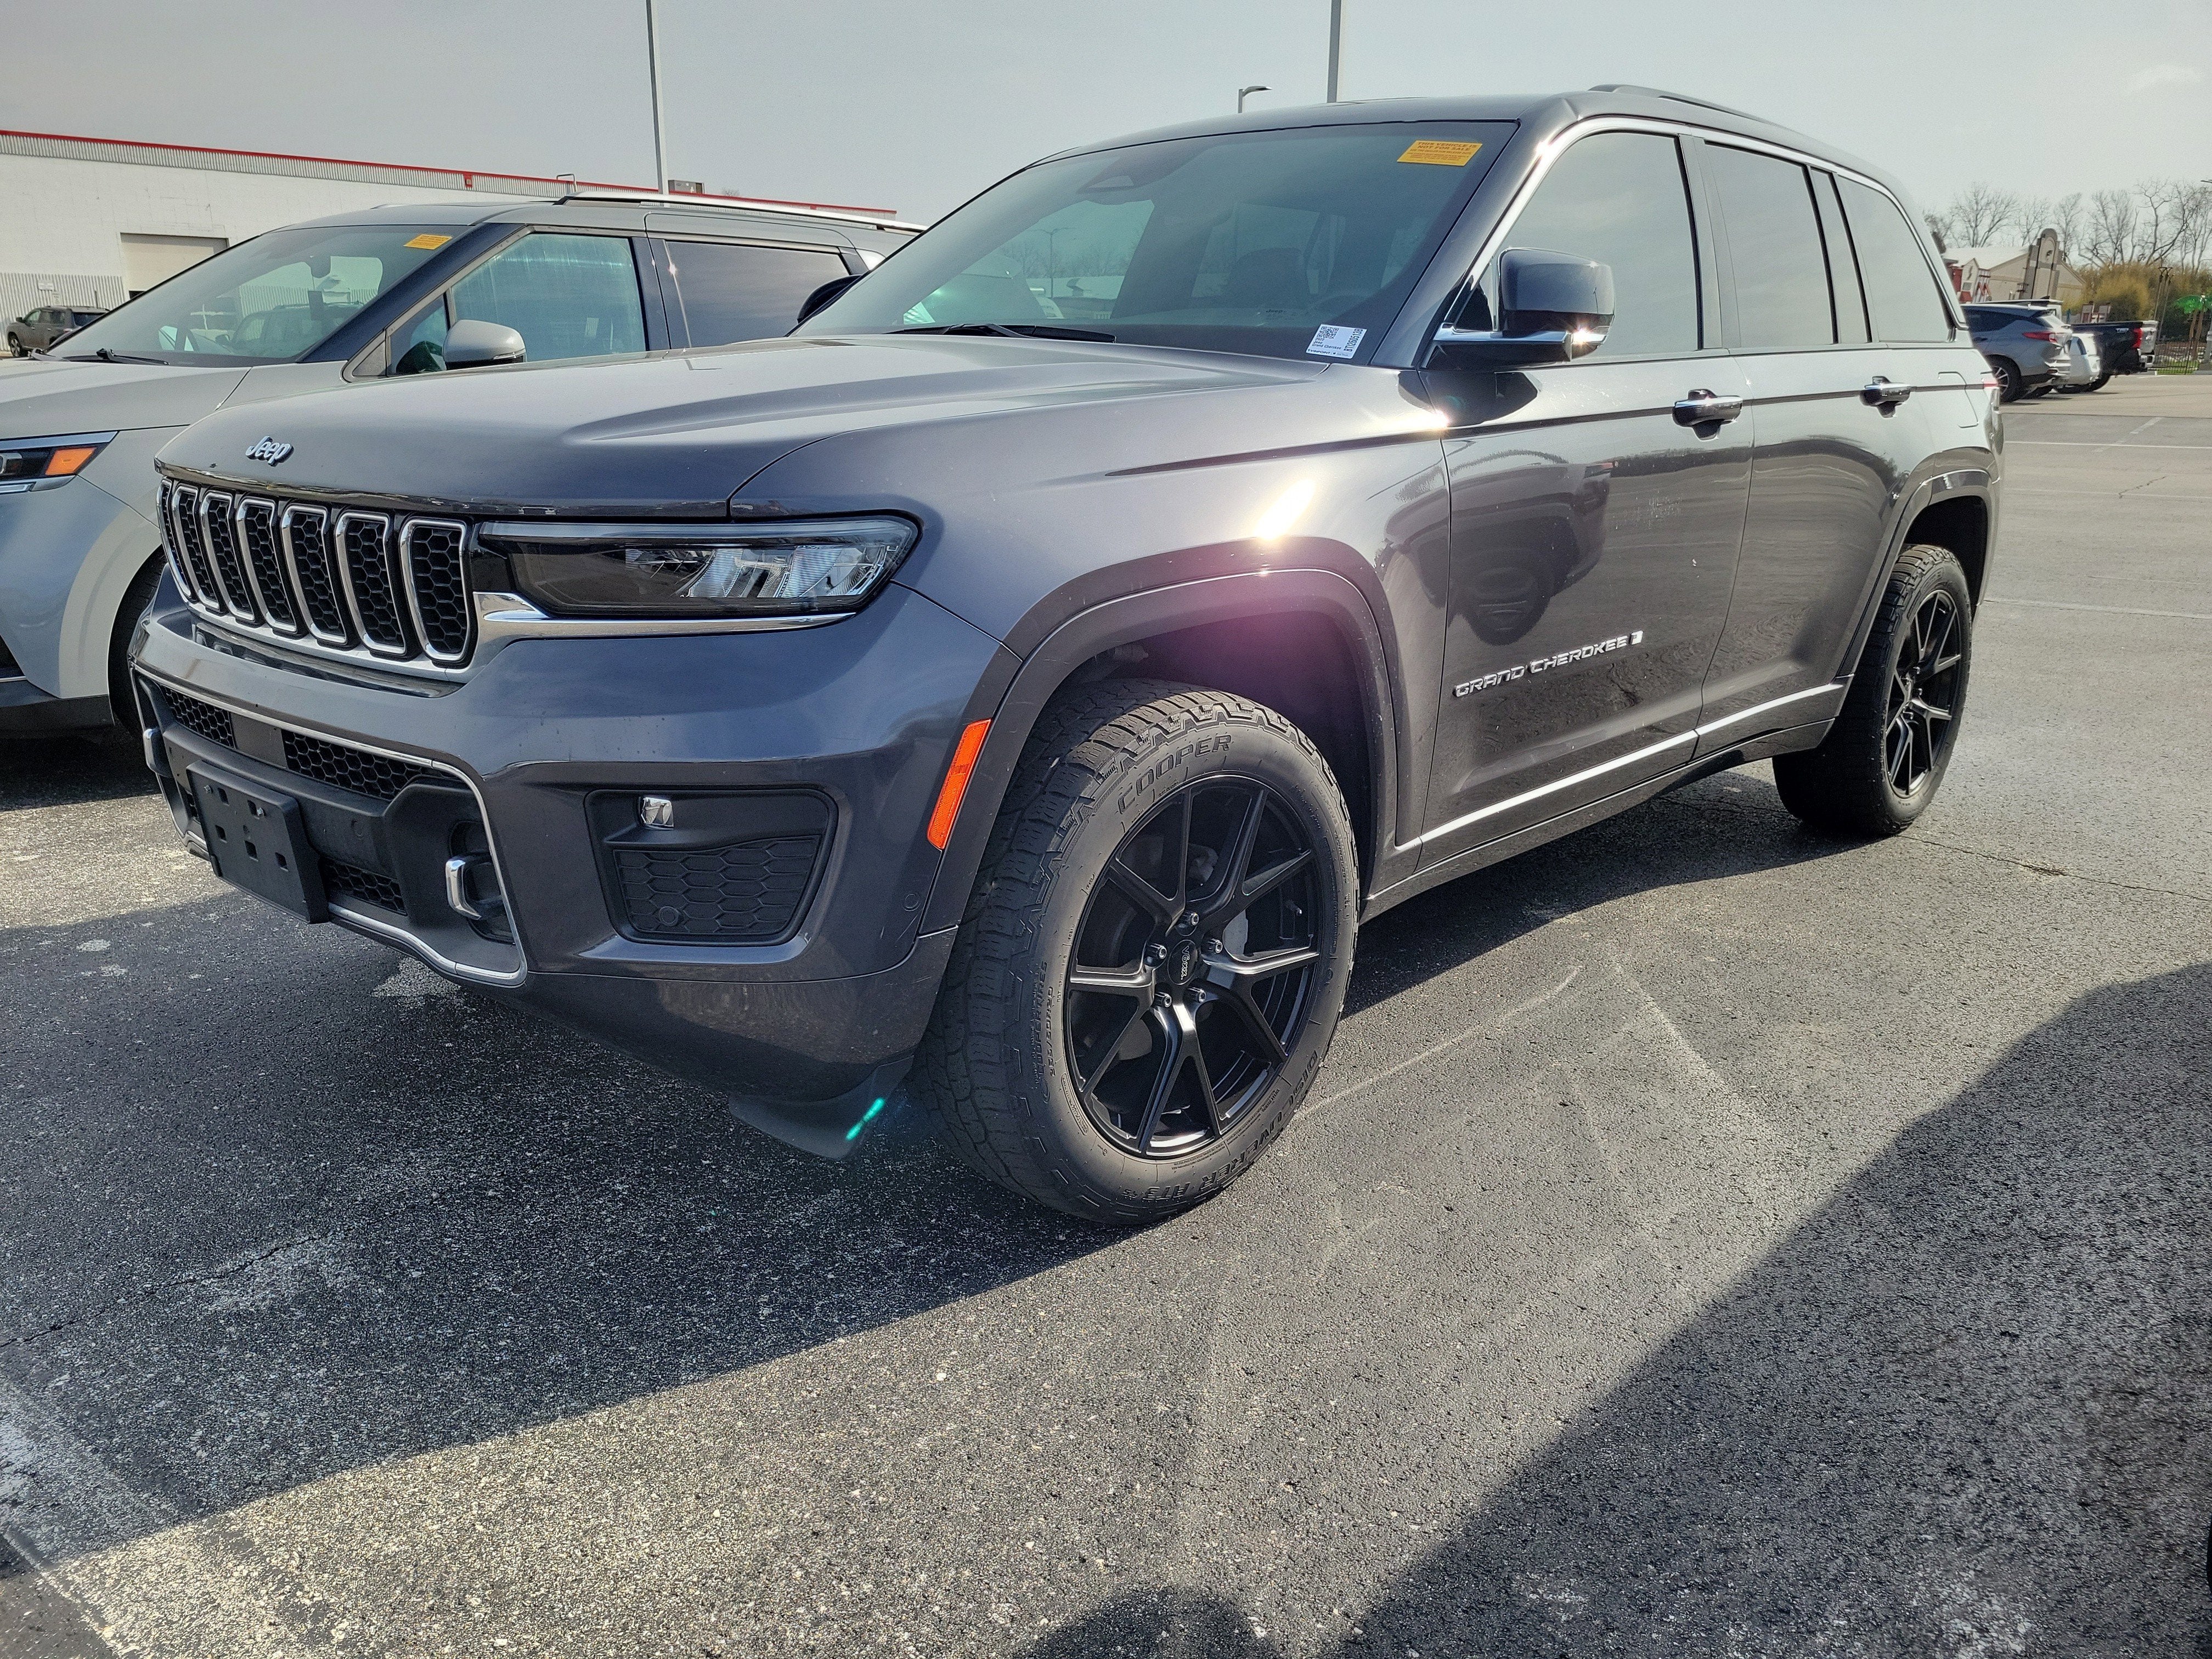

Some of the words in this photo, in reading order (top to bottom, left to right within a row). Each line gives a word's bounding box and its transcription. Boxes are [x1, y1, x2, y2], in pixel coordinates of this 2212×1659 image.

[245, 436, 293, 466] Jeep
[1454, 665, 1525, 697] GRAND
[1528, 635, 1628, 674] CHEROKEE
[1118, 734, 1232, 815] COOPER
